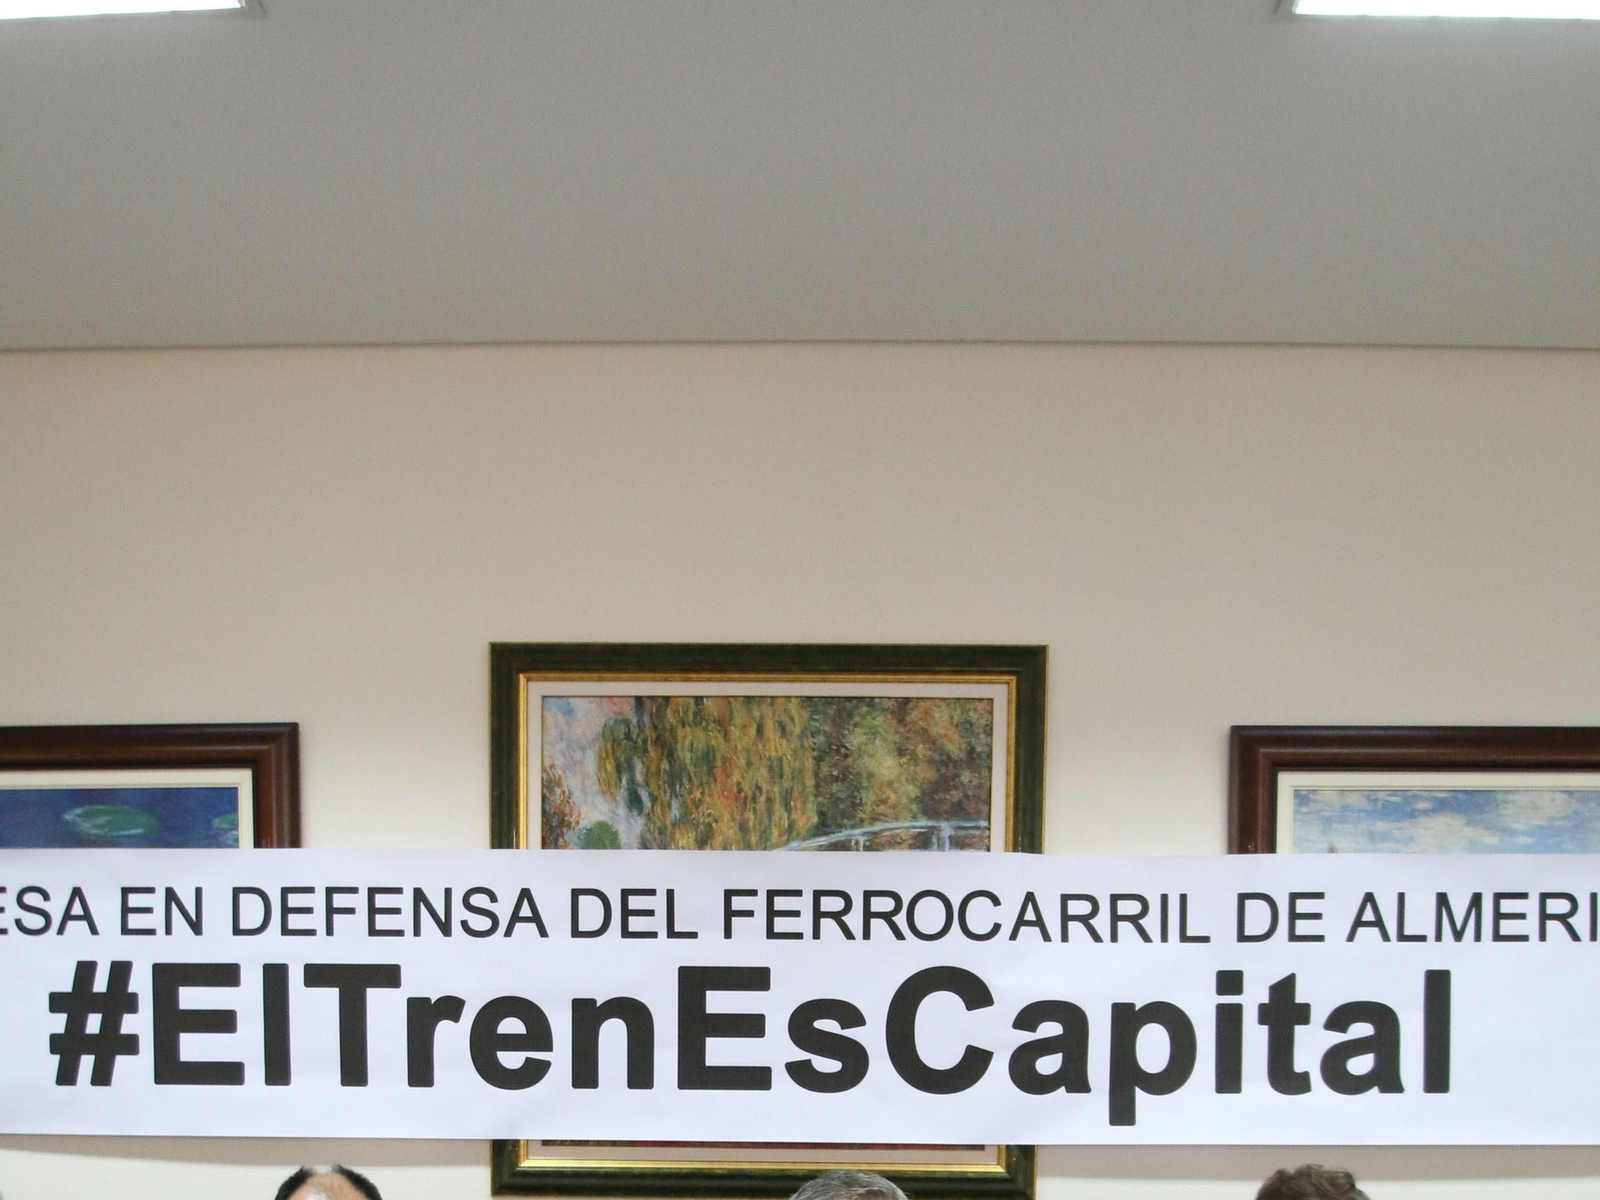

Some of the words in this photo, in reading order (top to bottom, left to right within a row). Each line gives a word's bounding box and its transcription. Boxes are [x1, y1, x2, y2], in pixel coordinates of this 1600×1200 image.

[0, 885, 100, 936] SA
[120, 886, 203, 936] EN
[232, 886, 549, 938] DEFENSA
[570, 888, 699, 940] DEL
[723, 888, 1211, 944] FERROCARRIL
[1236, 892, 1325, 943] DE
[1346, 891, 1598, 943] ALMERI
[48, 960, 1451, 1127] #ElTrenEsCapital
